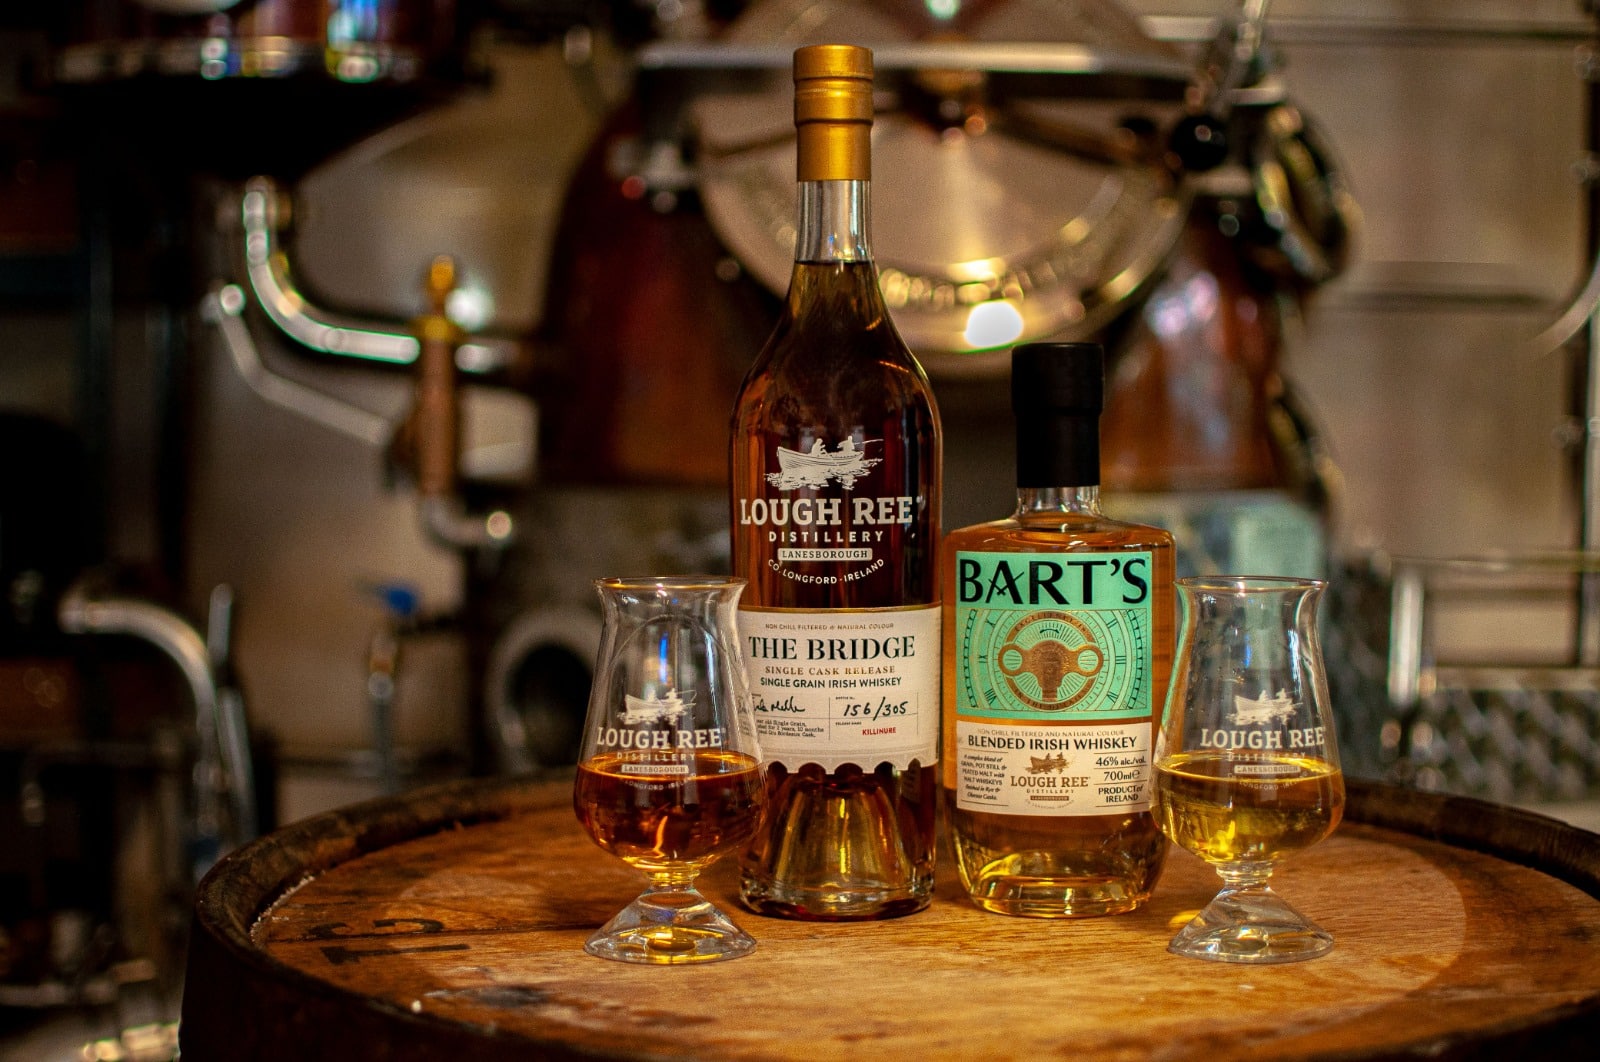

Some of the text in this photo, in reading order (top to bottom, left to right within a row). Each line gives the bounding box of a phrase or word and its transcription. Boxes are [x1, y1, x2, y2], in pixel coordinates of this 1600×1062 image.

[740, 496, 913, 526] LOUGH REE
[768, 530, 884, 543] DISTILLERY
[781, 550, 869, 559] LANESBOROUGH
[782, 569, 838, 585] LONGFORD
[843, 558, 885, 583] IRELAND
[779, 623, 796, 631] CHILL
[837, 623, 866, 631] NATURAL
[868, 622, 894, 631] COLOUR
[748, 635, 916, 661] THE BRIDGE
[765, 665, 896, 675] SINGLE CASK RELEASE
[760, 676, 902, 688] SINGLE GRAIN IRISH WHISKEY
[843, 696, 908, 721] 156/305
[862, 726, 896, 736] KILLINURE
[1096, 729, 1125, 737] COLOUR
[597, 726, 722, 750] LOUGH REE
[968, 734, 1138, 750] BLENDED IRISH WHISKEY
[1200, 726, 1325, 749] LOUGH REE
[616, 751, 695, 762] DISTILLERY
[1095, 756, 1119, 766] 46%
[1010, 775, 1089, 787] LOUGH REE
[1098, 785, 1137, 795] PRODUCT
[1105, 793, 1139, 803] IRELAND
